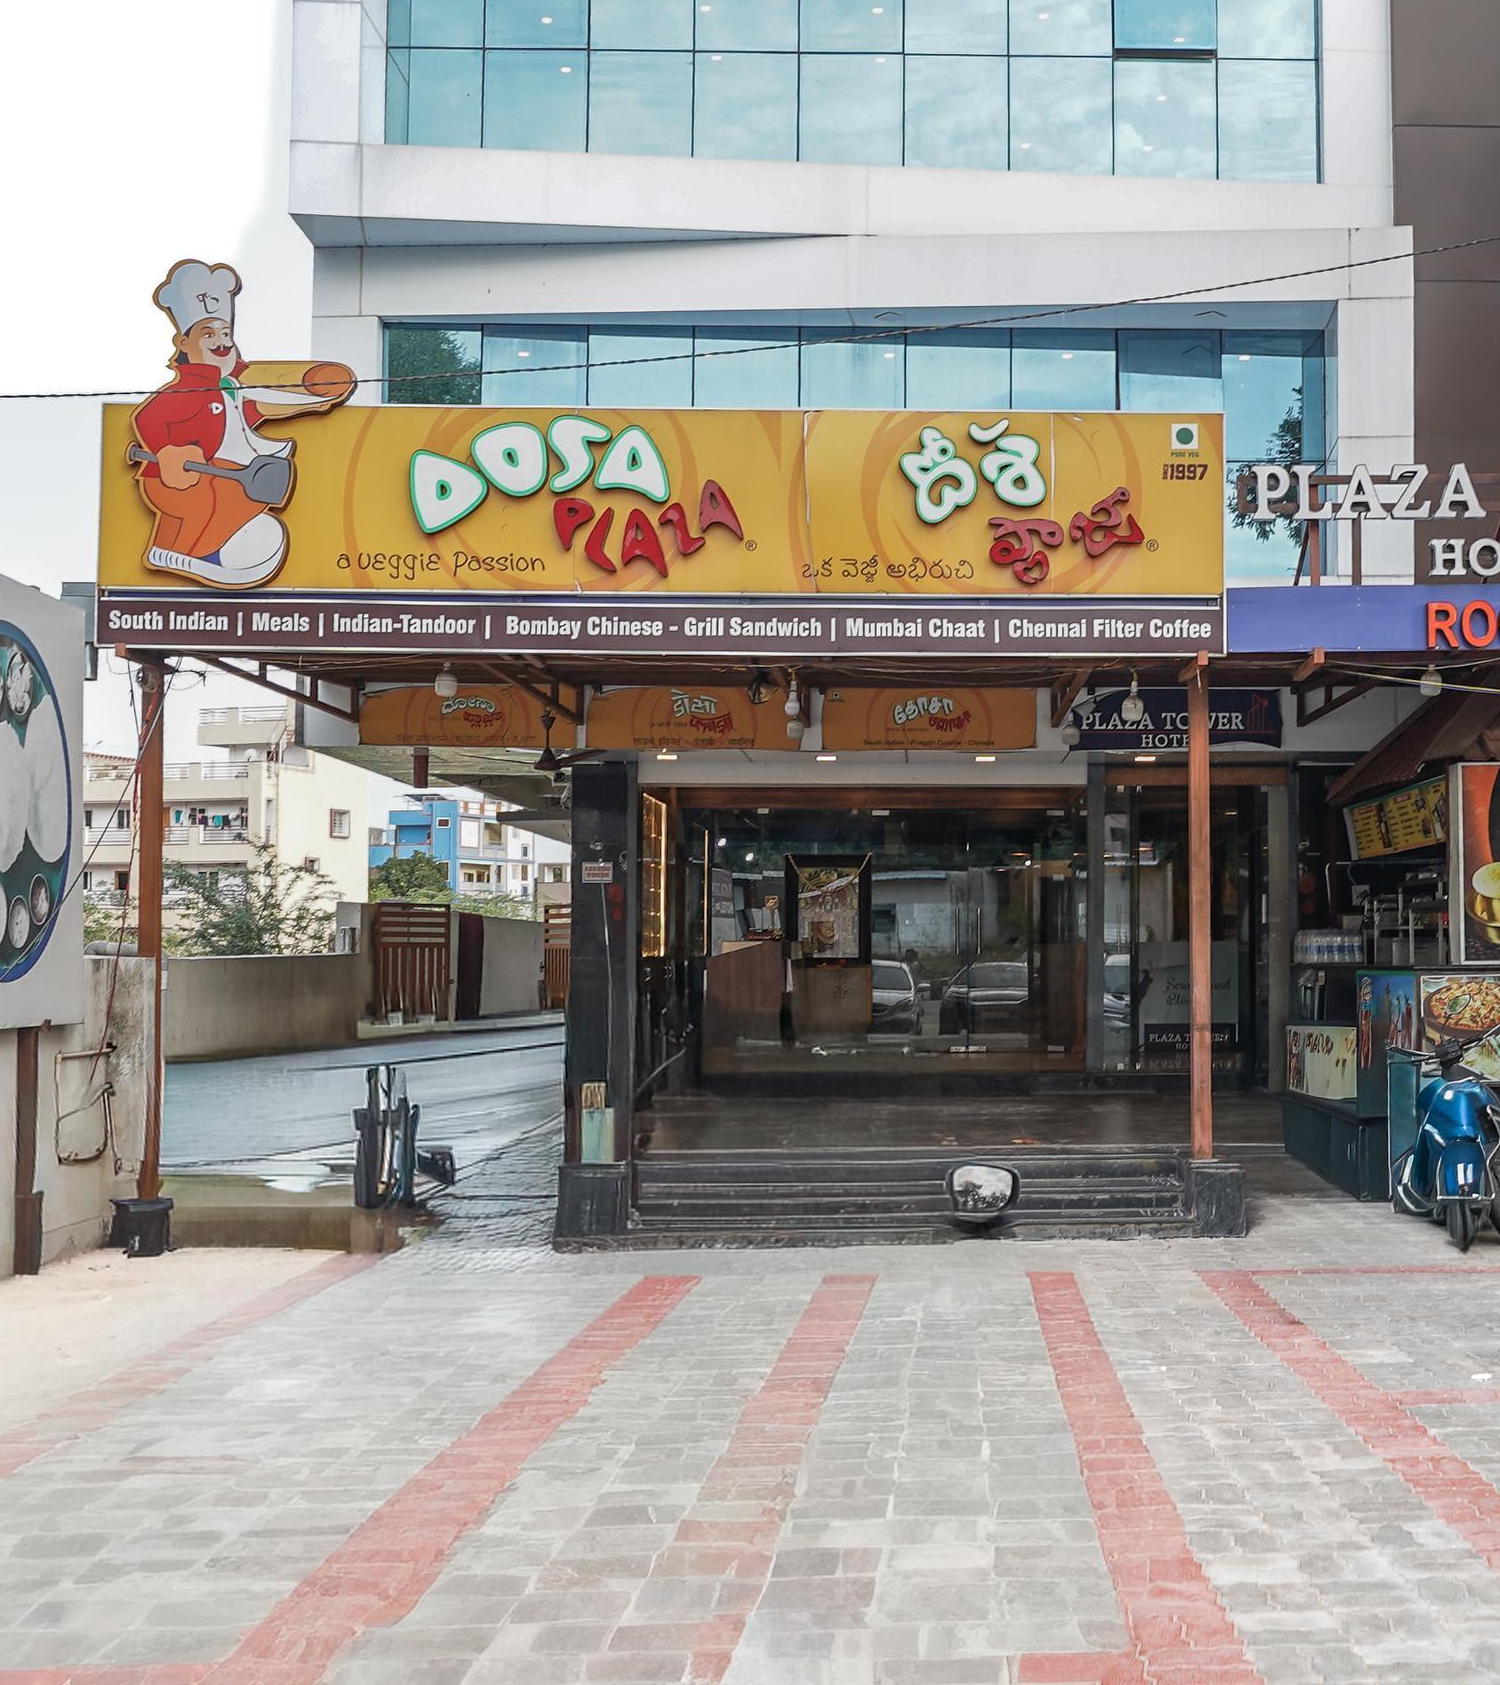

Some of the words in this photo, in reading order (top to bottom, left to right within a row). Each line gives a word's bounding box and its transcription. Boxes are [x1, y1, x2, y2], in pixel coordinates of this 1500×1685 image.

[409, 415, 671, 533] DOSA
[1169, 463, 1209, 481] 1997
[1249, 462, 1487, 520] PLAZA
[553, 479, 745, 578] PLAZA
[108, 609, 164, 631] South
[169, 610, 229, 632] Indian
[252, 612, 311, 633] Meals
[332, 613, 477, 635] Indian-Tandoor
[505, 616, 582, 640] Bombay
[586, 616, 664, 636] Chinese
[683, 616, 725, 638] Grill
[728, 616, 823, 638] Sandwich
[845, 617, 923, 639] Mumbai
[927, 617, 987, 639] Chaat
[1007, 617, 1088, 639] Chennai
[1092, 617, 1145, 640] Filter
[1148, 617, 1212, 640] Coffee
[1141, 734, 1189, 748] HOTE
[1149, 1033, 1182, 1043] PLAZA
